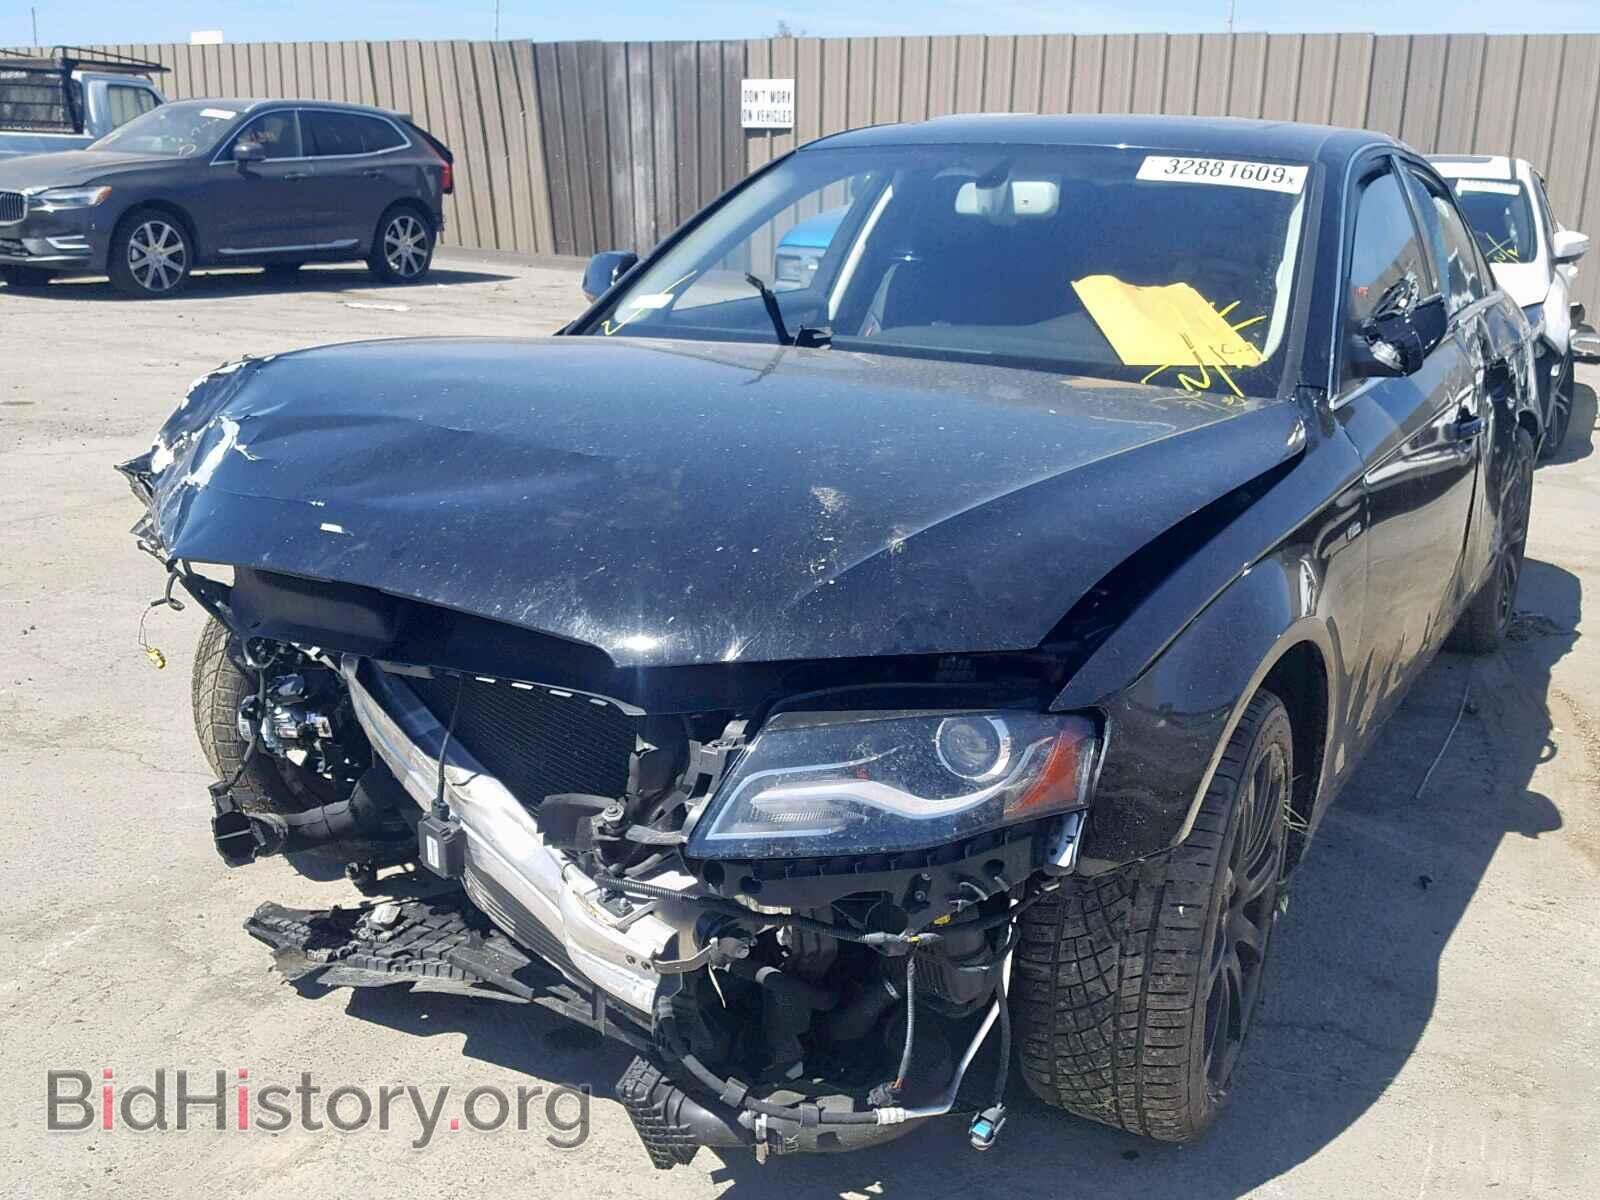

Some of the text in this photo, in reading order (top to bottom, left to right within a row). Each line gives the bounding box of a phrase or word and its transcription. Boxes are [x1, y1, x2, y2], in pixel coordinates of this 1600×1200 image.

[743, 89, 791, 105] DON'T WORK
[742, 108, 792, 123] ON VEHICLES
